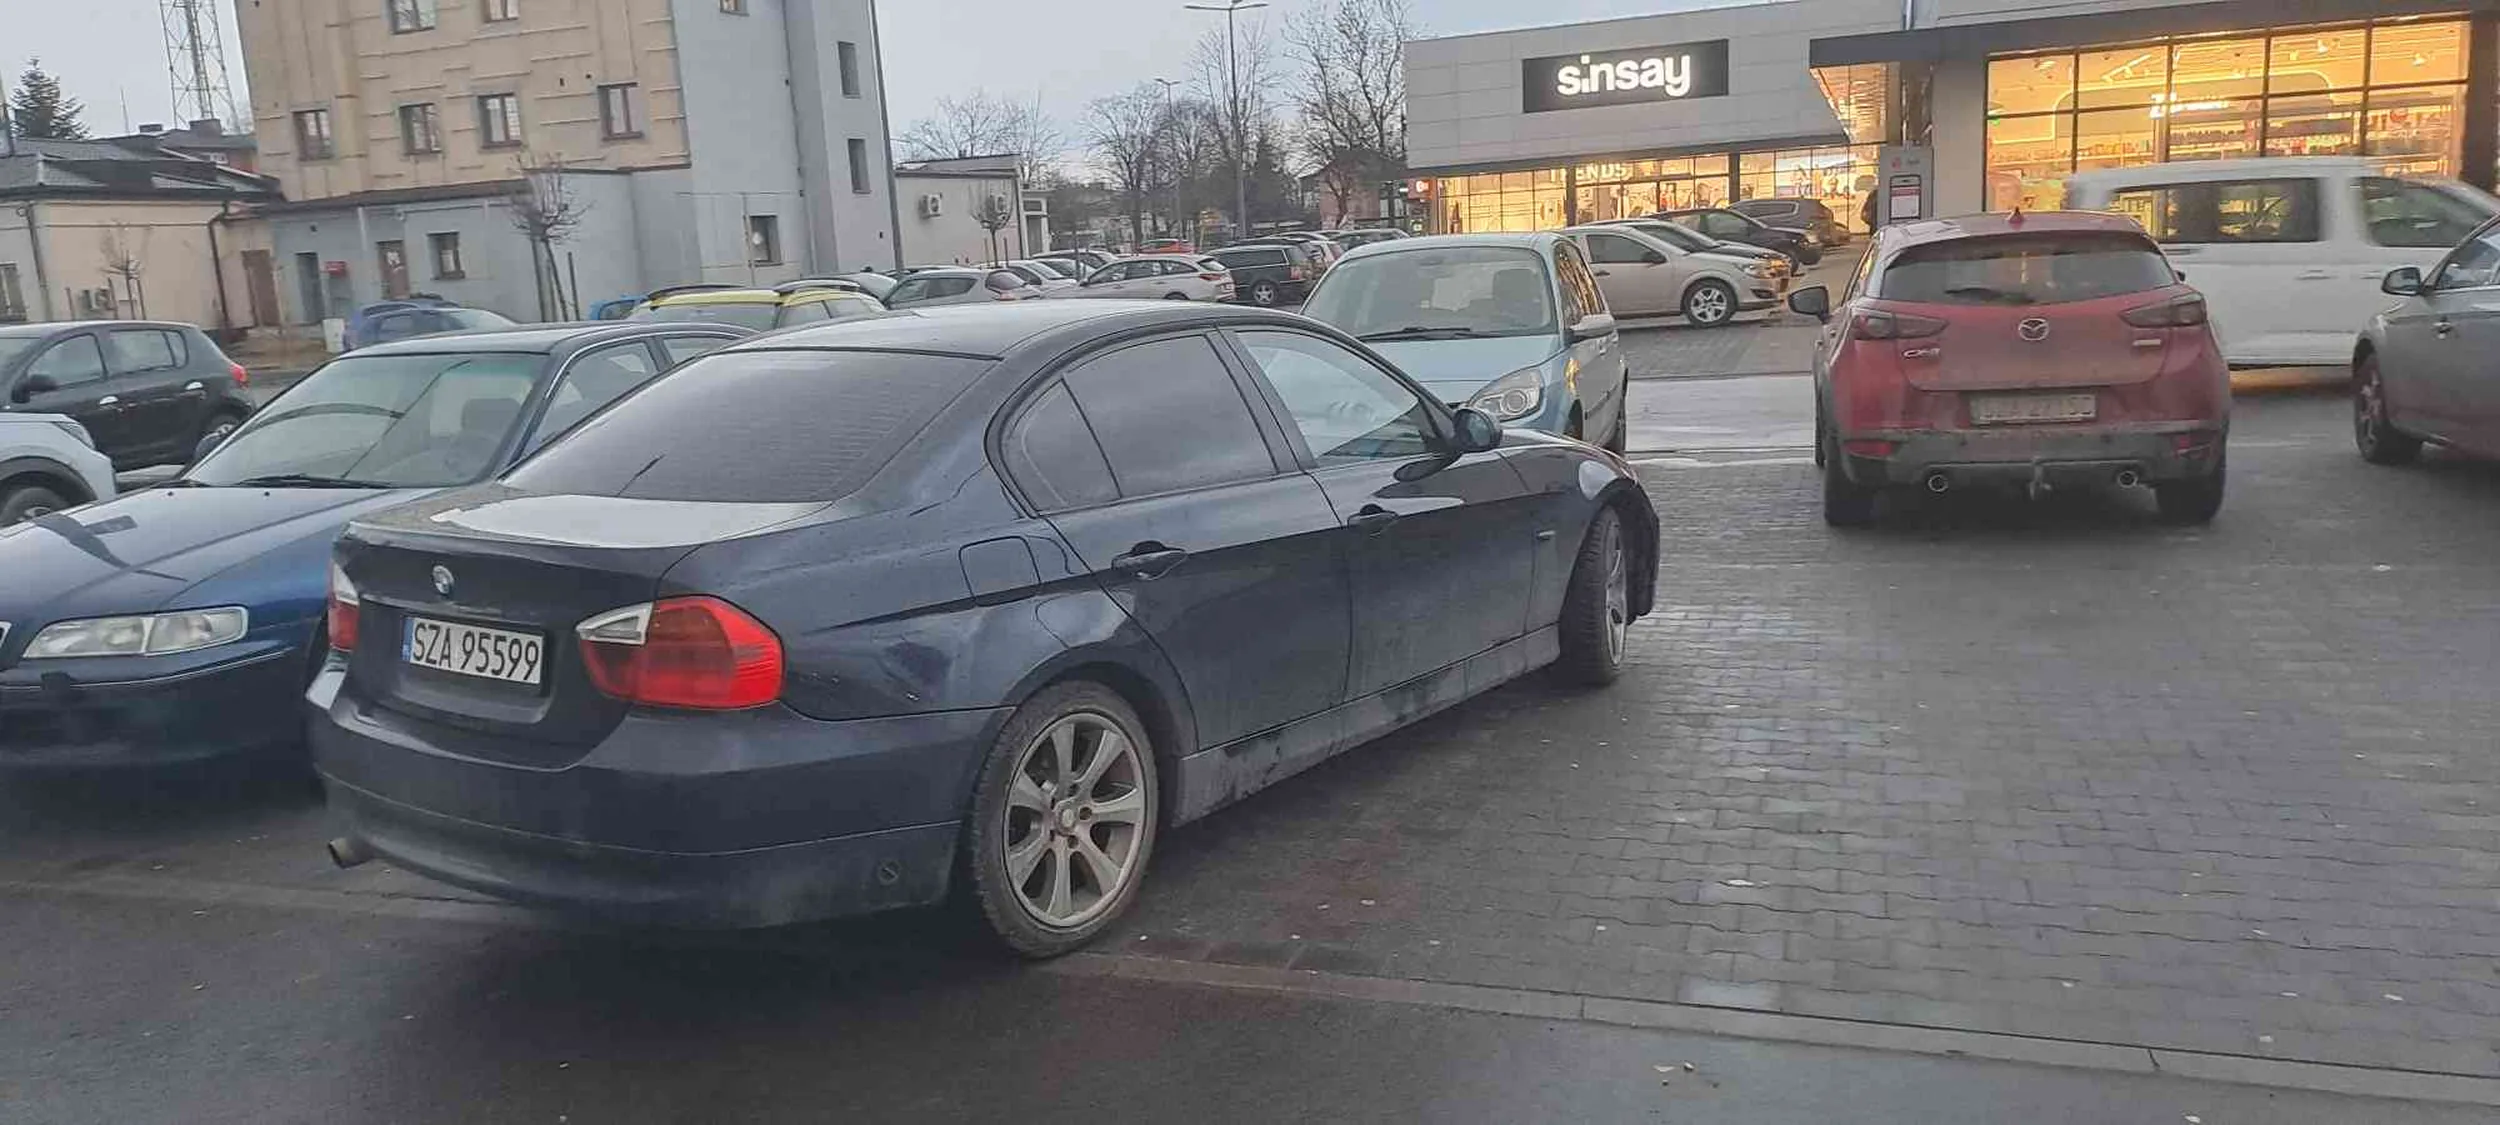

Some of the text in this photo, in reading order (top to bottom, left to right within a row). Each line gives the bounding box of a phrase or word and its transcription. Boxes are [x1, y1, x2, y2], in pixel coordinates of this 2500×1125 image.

[1557, 55, 1690, 97] sinsay
[1550, 163, 1626, 182] ENDS
[413, 622, 539, 681] SZA 95599
